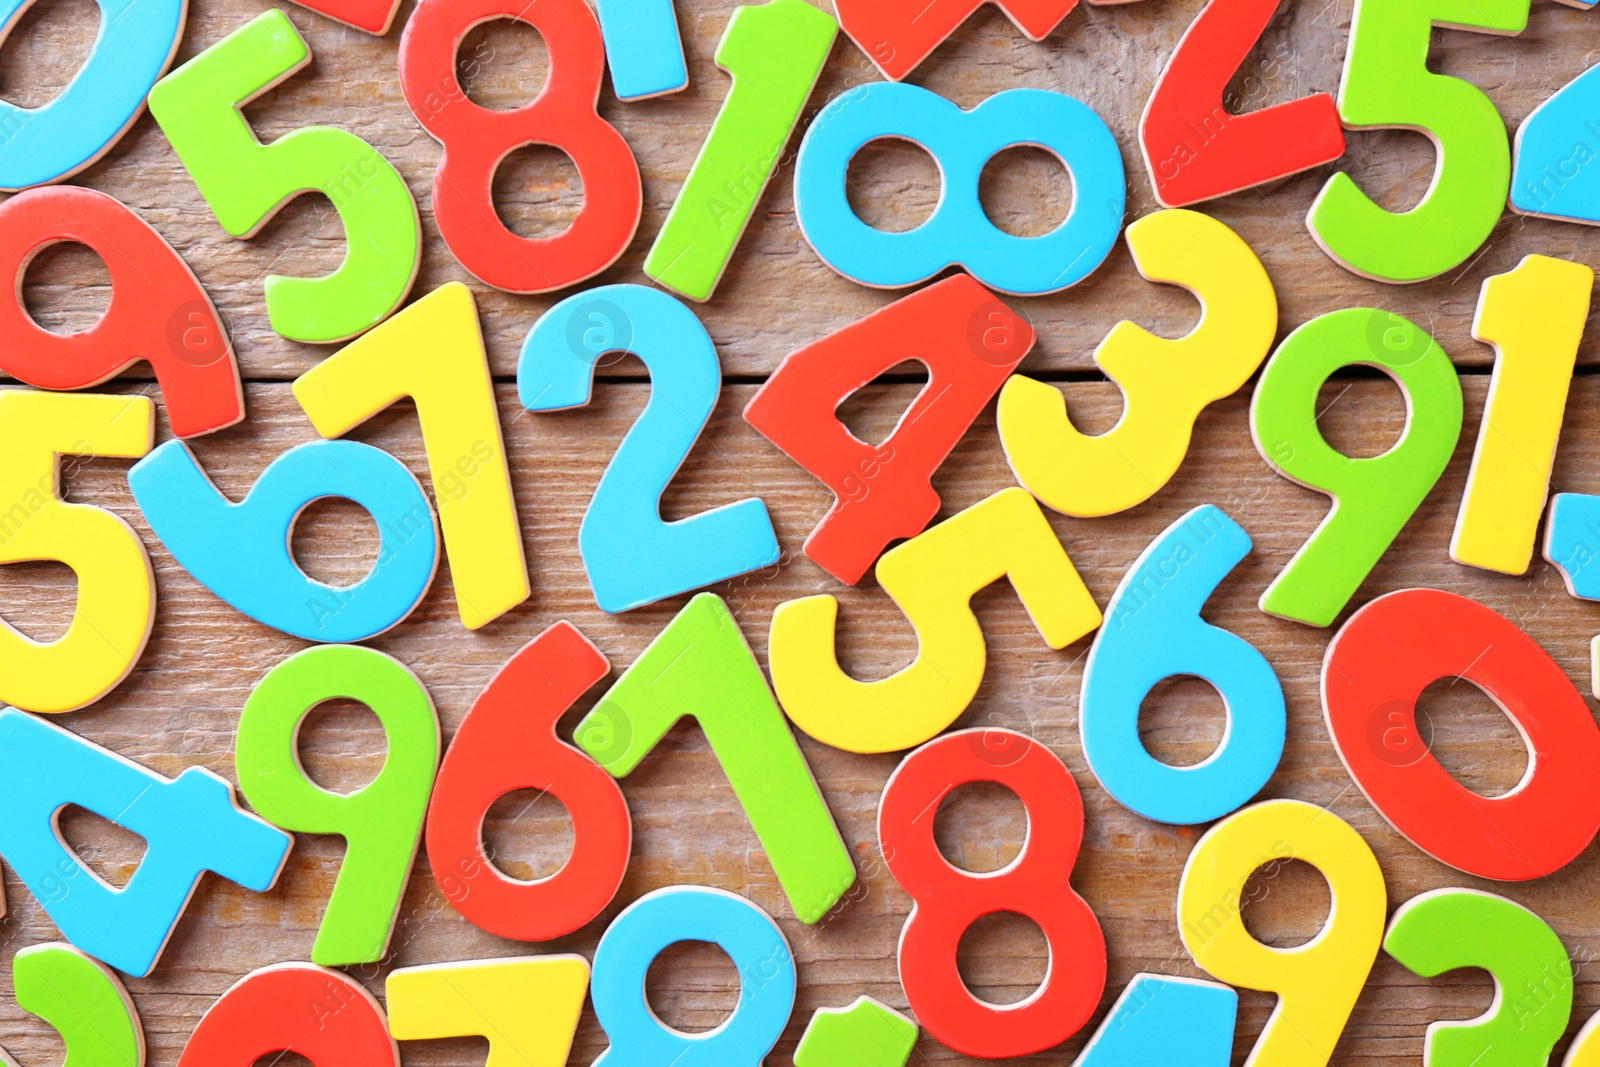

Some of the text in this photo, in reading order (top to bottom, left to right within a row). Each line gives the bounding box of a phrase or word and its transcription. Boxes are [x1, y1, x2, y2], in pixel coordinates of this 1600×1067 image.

[149, 8, 422, 344] 5
[398, 0, 644, 295] 8
[642, 0, 838, 304] 1
[795, 82, 1127, 297] 8
[1307, 0, 1530, 284] 5
[291, 281, 531, 631] 7
[517, 284, 780, 614] 2
[743, 272, 1036, 587] 4
[996, 208, 1279, 518] 3
[1250, 306, 1464, 629] 9
[1449, 253, 1594, 576] 1
[0, 388, 156, 714] 5
[769, 486, 1103, 755] 5
[1080, 503, 1287, 827] 6
[0, 706, 295, 979] 4
[236, 642, 442, 967] 9
[425, 620, 632, 943] 6
[572, 592, 856, 925] 7
[879, 727, 1108, 1059] 8
[1321, 587, 1600, 882] 0
[1177, 798, 1388, 1067] 9
